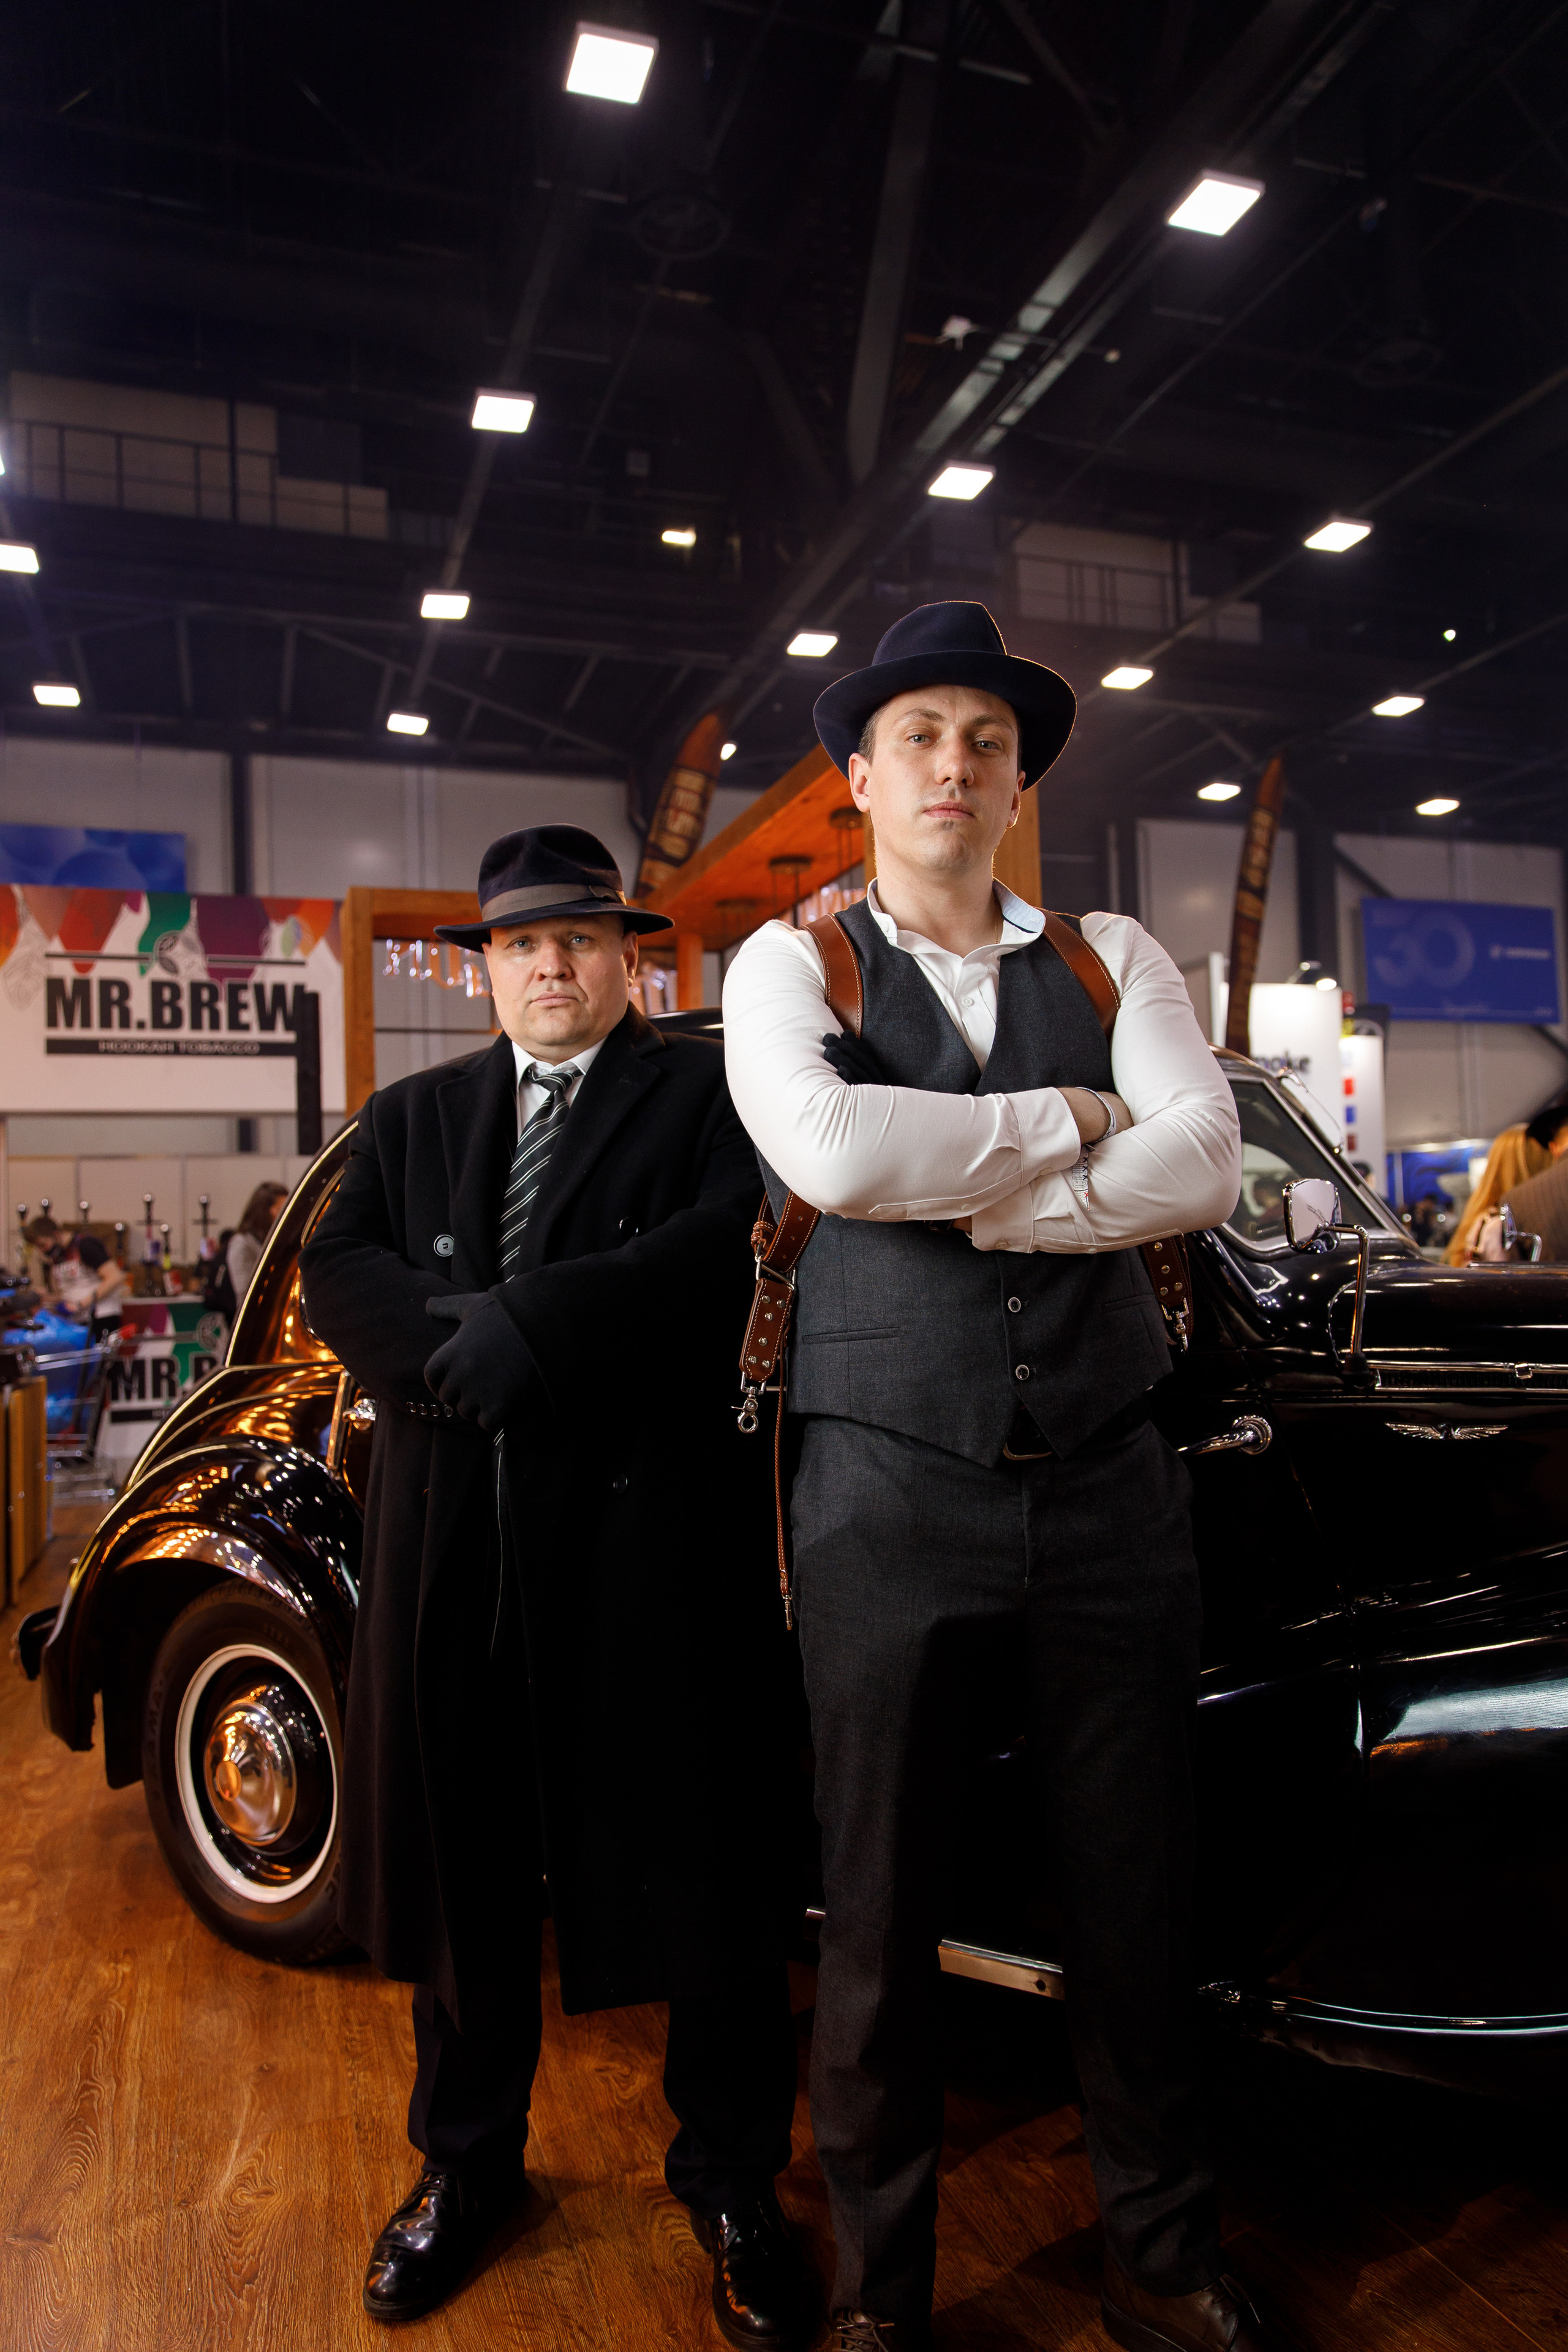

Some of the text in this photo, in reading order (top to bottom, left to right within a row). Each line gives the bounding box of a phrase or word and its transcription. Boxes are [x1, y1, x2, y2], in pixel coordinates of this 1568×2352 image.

[46, 977, 305, 1031] MR.BREW
[99, 1041, 260, 1055] HOOKAH TOBACCO
